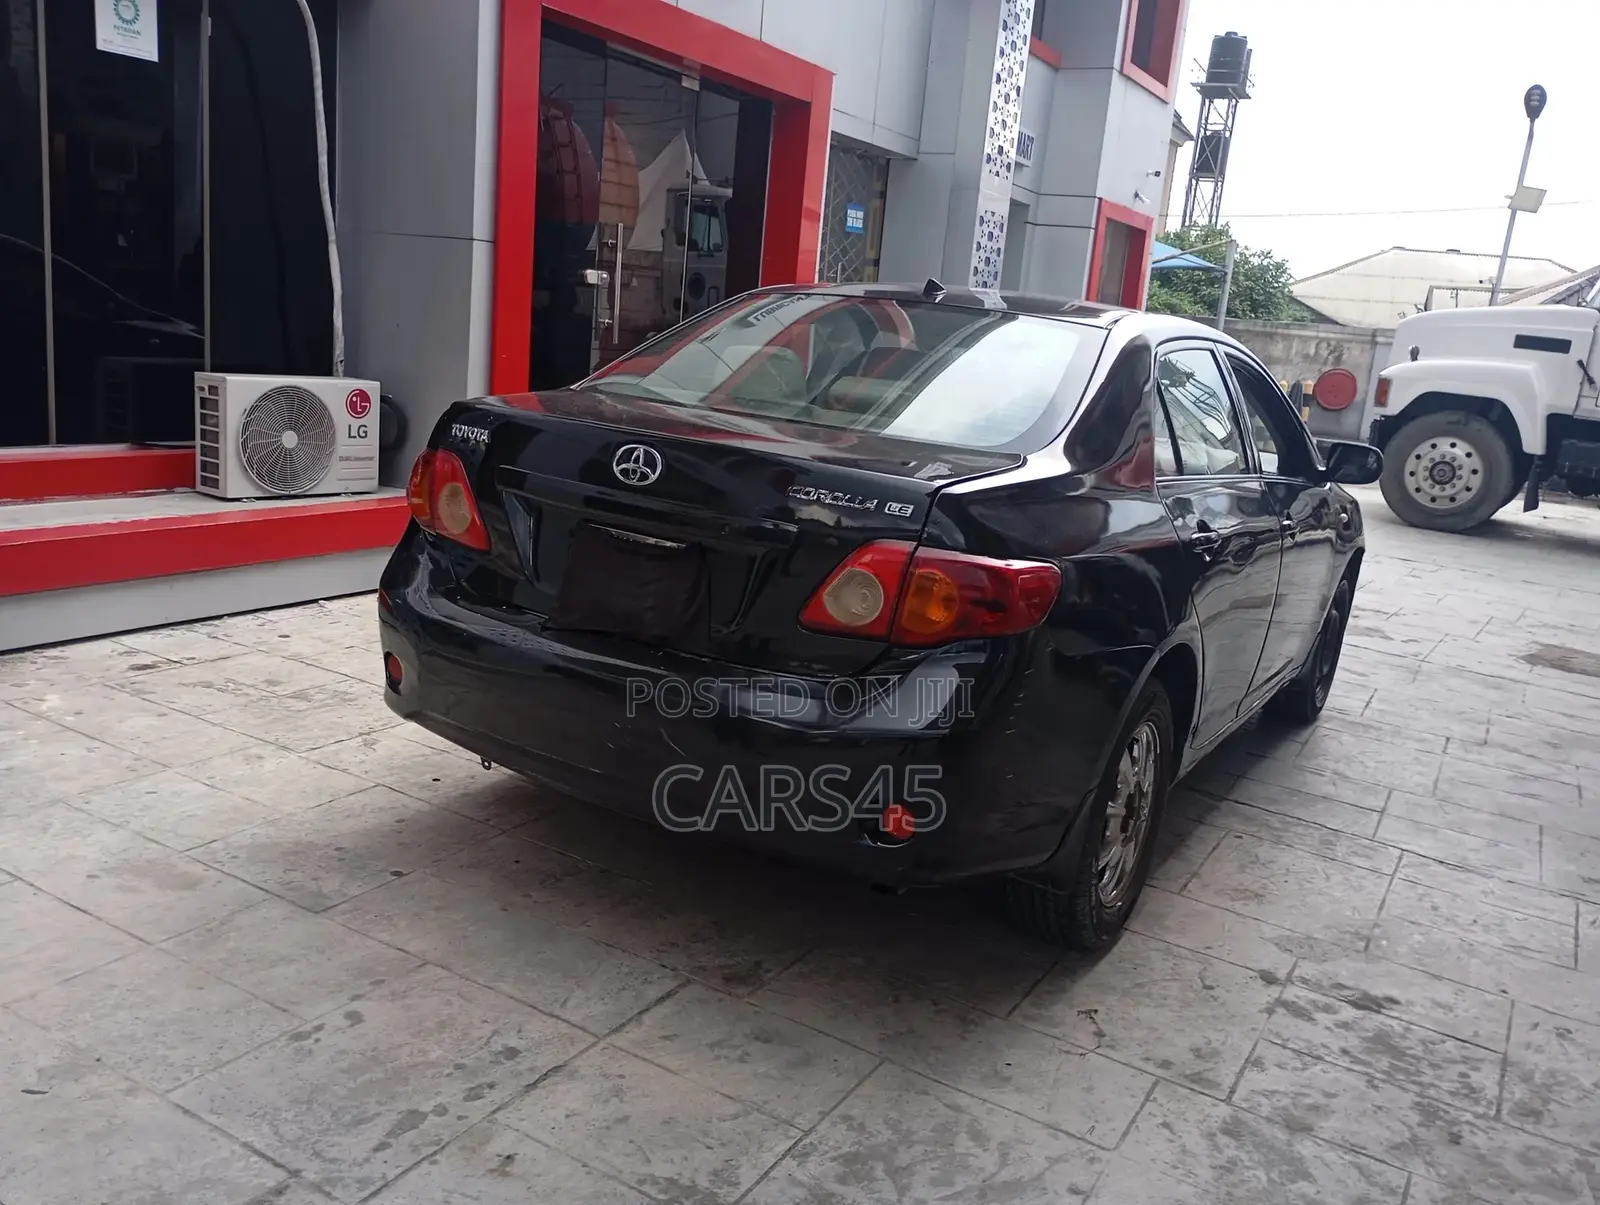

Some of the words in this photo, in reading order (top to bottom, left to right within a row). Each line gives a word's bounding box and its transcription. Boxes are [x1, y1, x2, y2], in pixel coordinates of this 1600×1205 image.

[348, 424, 368, 439] LG
[452, 424, 489, 443] TOYOTA
[786, 485, 878, 512] COROLLA
